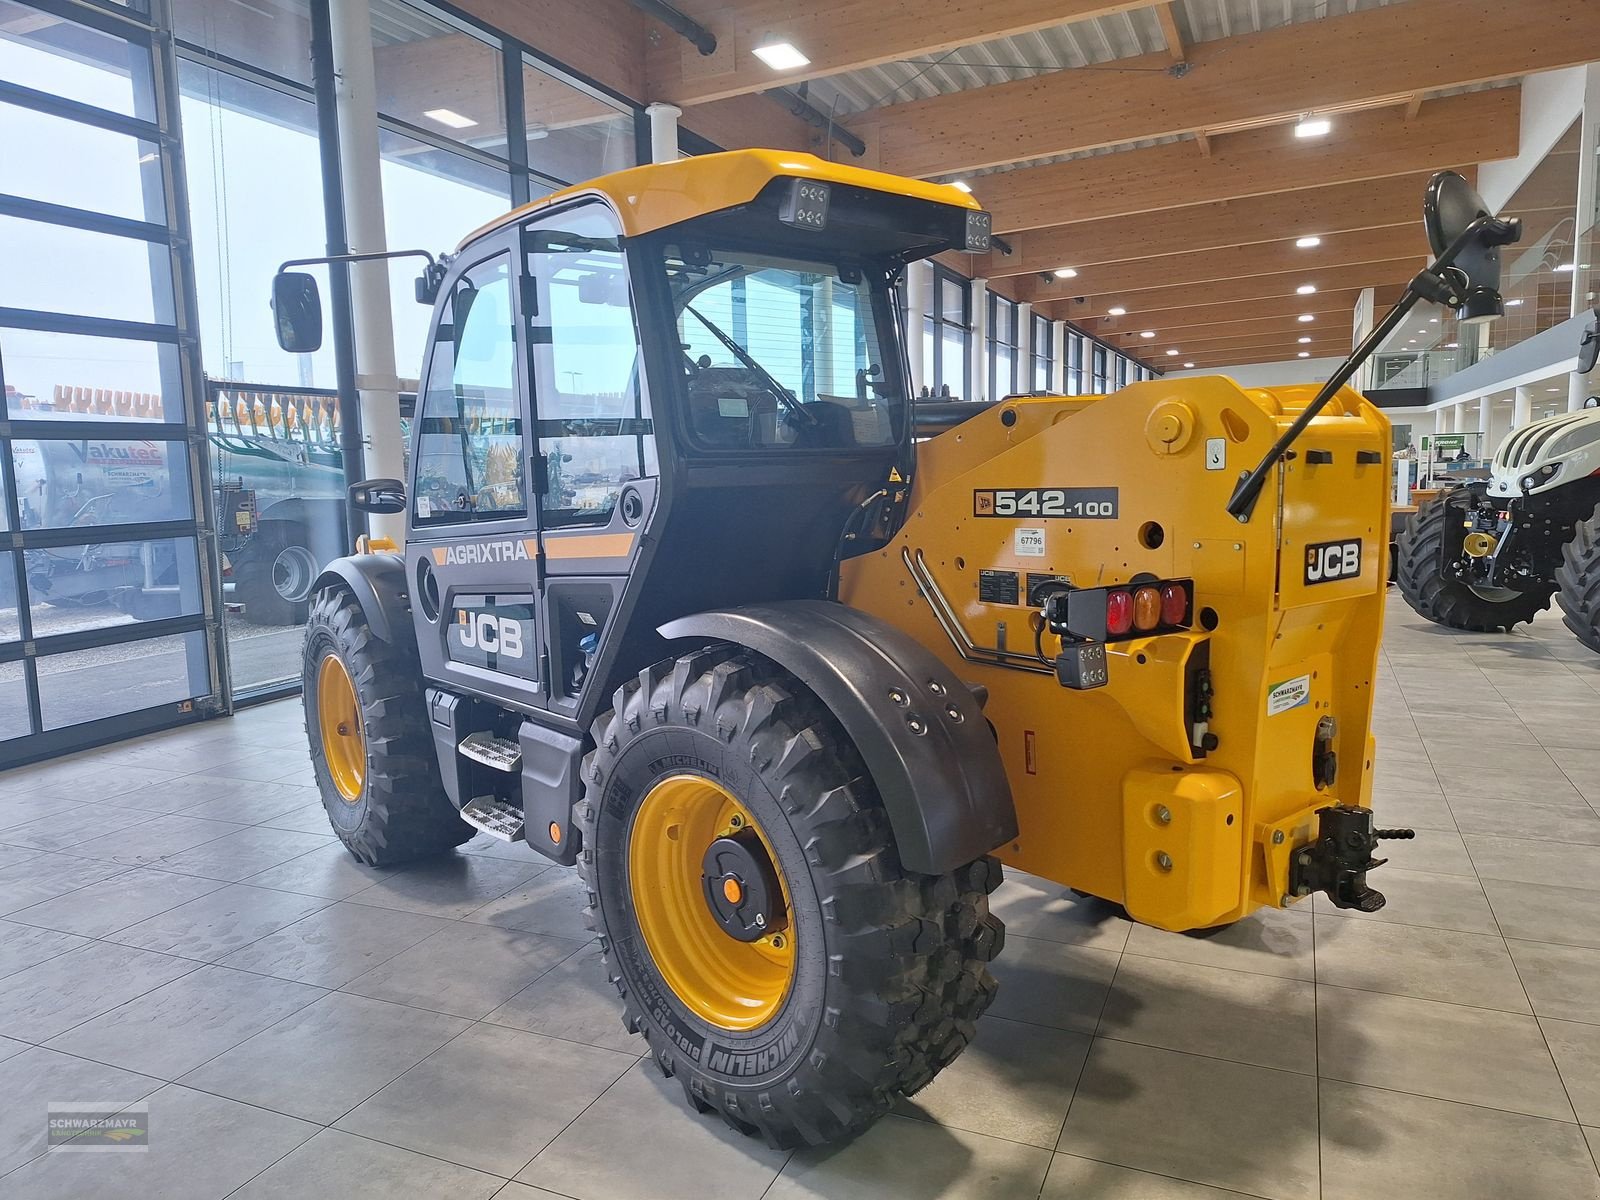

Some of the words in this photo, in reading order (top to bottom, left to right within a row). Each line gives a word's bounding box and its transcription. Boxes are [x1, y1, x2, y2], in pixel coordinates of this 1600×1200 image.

[67, 439, 163, 464] Vakutec
[445, 539, 529, 566] AGRIXTRA
[1020, 536, 1042, 545] 67796
[1307, 543, 1359, 581] JCB
[459, 611, 523, 659] JCB
[1272, 684, 1303, 699] SCHWARZMAYR
[661, 755, 719, 775] MICHELIN
[652, 1007, 701, 1062] BIBLOAD
[708, 1023, 799, 1076] MICHELIN
